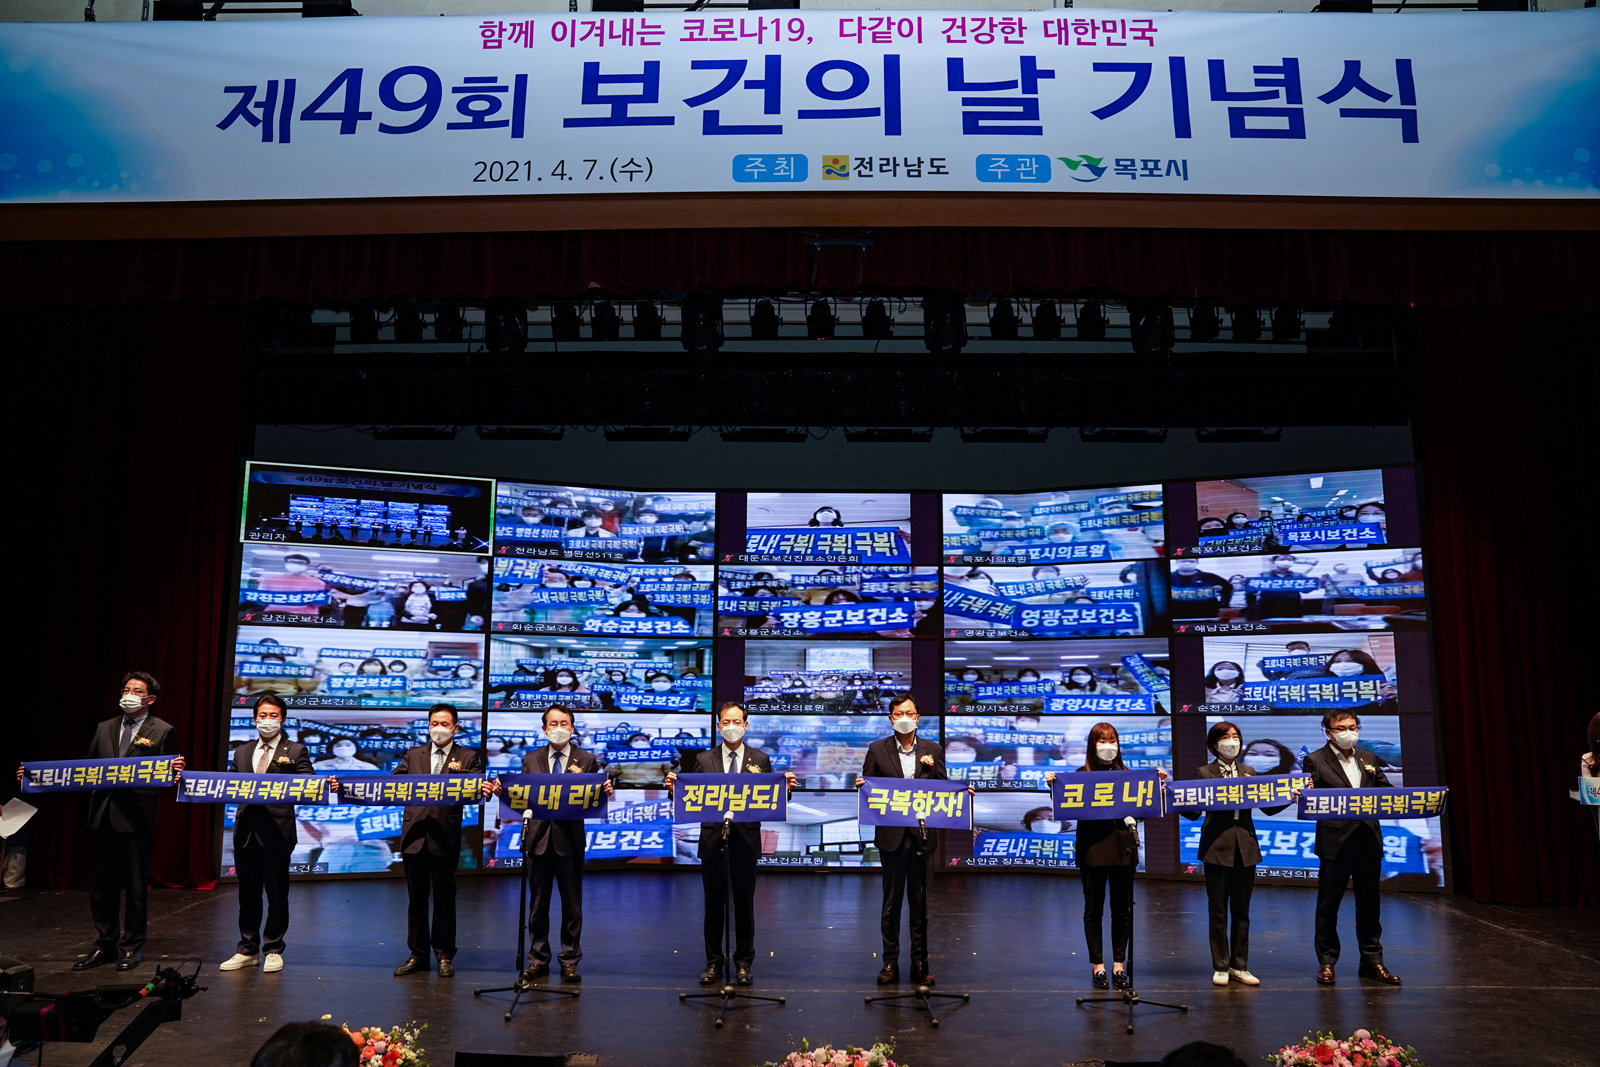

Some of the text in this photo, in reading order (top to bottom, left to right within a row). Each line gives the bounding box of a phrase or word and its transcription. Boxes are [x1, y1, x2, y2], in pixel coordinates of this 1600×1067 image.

[478, 17, 1159, 49] 함께 이겨내는 코로나19, 다같이 건강한 대한민국
[216, 53, 1420, 145] 제49회 보건의 날 기념식
[852, 155, 950, 180] 전라남도
[1113, 157, 1190, 182] 목포시
[248, 531, 287, 542] 관리자
[1288, 527, 1377, 542] 목포시보건소
[515, 546, 559, 556] 전라남도
[746, 531, 899, 557] 로나! 극복! 극복! 극복!
[1191, 544, 1263, 554] 목포시보건소
[963, 555, 1027, 563] 목포시의료원
[1248, 579, 1316, 589] 해남군보건소
[779, 607, 909, 629] 장흥군보건소
[1021, 608, 1133, 627] 영광군보건소
[511, 623, 579, 632] 화순군보건소
[583, 619, 690, 634] 화순군보건소
[738, 628, 803, 636] 장흥군보건소
[964, 629, 1029, 637] 영광군보건소
[1194, 623, 1267, 633] 해남군보건소
[330, 677, 403, 688] 장성군보건소
[1243, 680, 1382, 702] 코로나! 극복! 극복! 극복!
[283, 697, 358, 706] 장성군보건소
[620, 694, 691, 707] 신안군보건소
[743, 703, 824, 712] 도군보건의료원
[1049, 698, 1147, 712] 광양시보건소
[1197, 703, 1271, 712] 순천시보건소
[964, 705, 1030, 713] 광양시보건소
[606, 750, 672, 760] 무안군보건소
[29, 760, 174, 787] 코로나! 극복! 극복! 극복!
[184, 778, 326, 801] 코로나! 극복! 극복! 극복!
[343, 778, 482, 801] 코로나! 극복! 극복! 극복!
[1172, 786, 1214, 806] 코로나!
[1216, 784, 1244, 805] 극복!
[1246, 782, 1275, 803] 극복!
[682, 784, 779, 811] 전라남도!
[867, 788, 963, 818] 극복하자!
[1304, 791, 1446, 815] 코로나! 극복! 극복! 극복!
[980, 838, 1059, 858] 코로나! 극복!
[966, 857, 998, 866] 신안군
